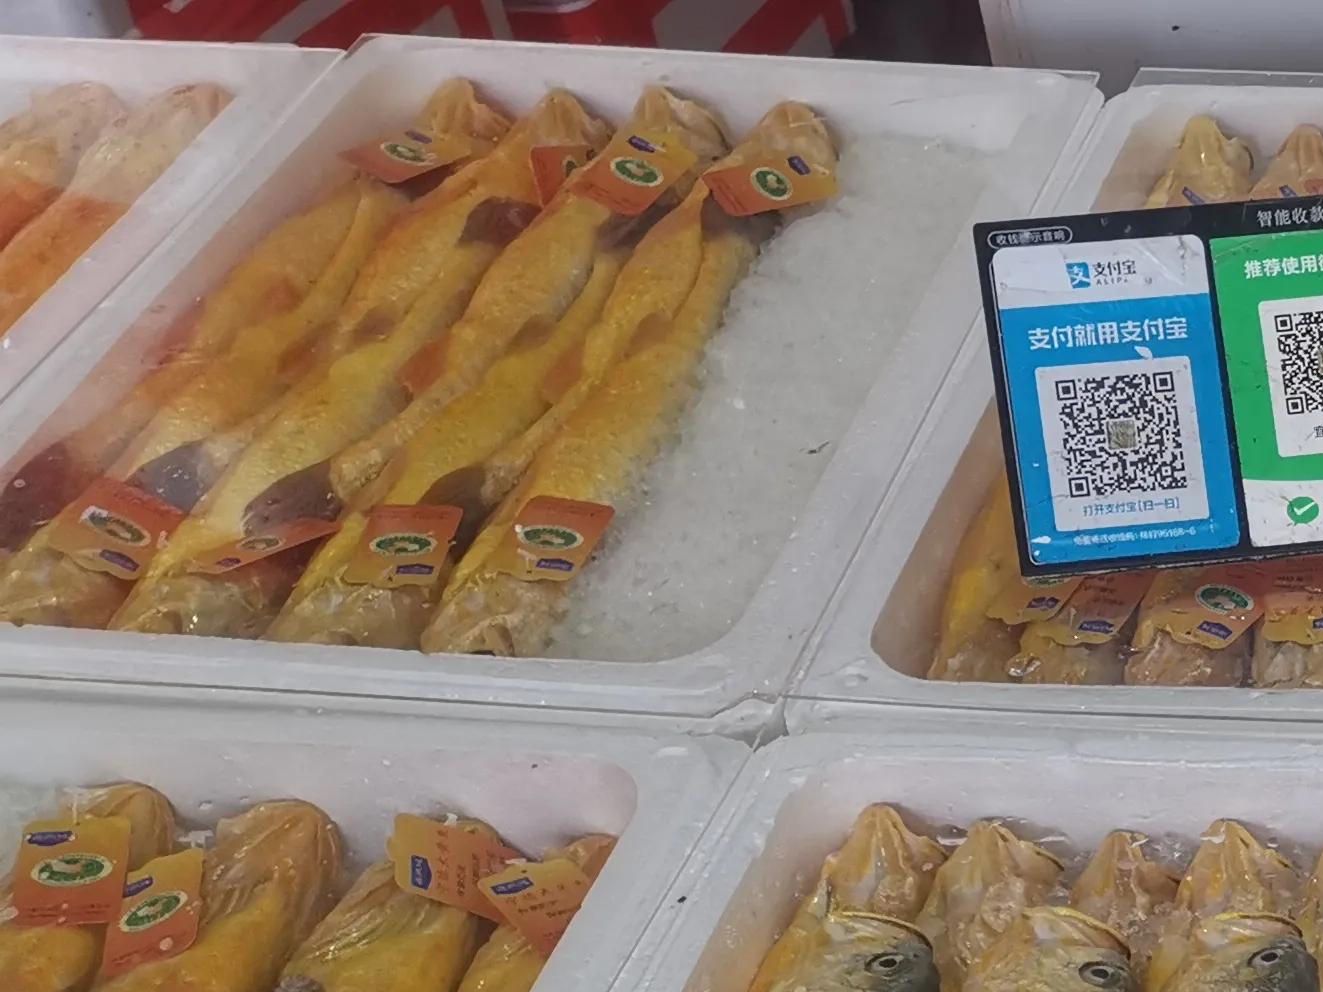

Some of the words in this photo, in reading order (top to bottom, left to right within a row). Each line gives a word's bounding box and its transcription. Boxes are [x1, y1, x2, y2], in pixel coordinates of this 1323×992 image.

[1093, 259, 1137, 278] 支付宝
[1028, 317, 1189, 351] 支付就用支付宝
